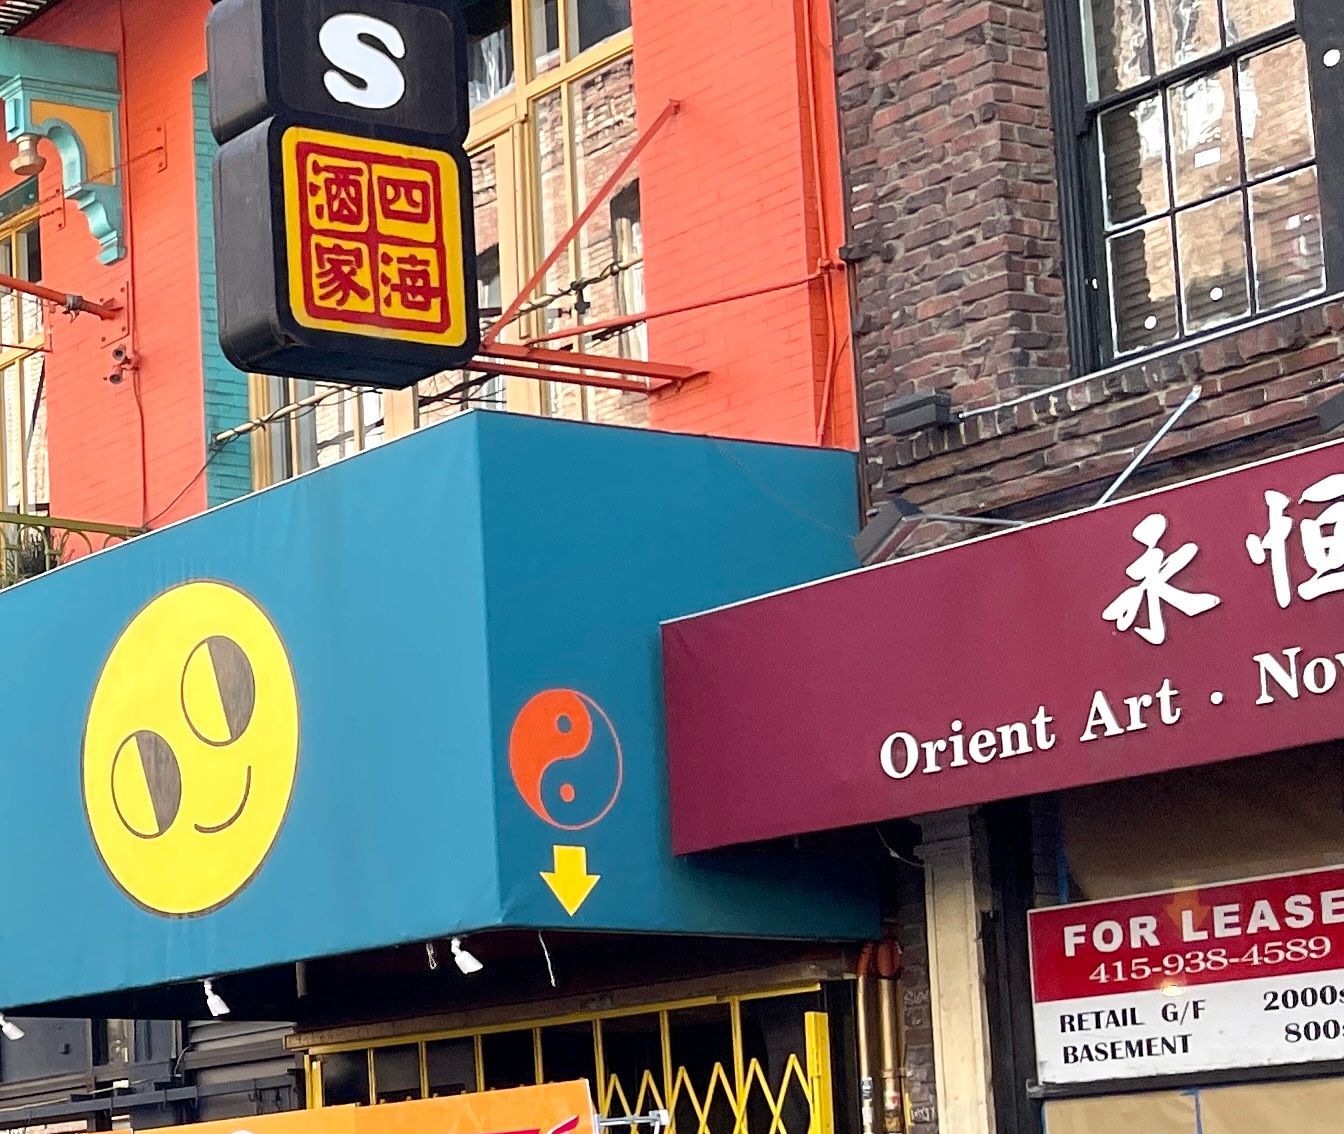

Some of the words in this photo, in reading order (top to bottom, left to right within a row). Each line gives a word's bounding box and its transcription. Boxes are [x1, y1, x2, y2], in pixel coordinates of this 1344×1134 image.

[318, 12, 407, 110] S
[880, 705, 1056, 780] Orient
[1080, 678, 1181, 742] Art
[1064, 916, 1161, 957] FOR
[1182, 889, 1344, 942] LEASE
[1089, 936, 1331, 984] 415-938-4589
[1060, 1007, 1145, 1033] RETAIL
[1162, 1000, 1207, 1025] G/F
[1063, 1034, 1193, 1065] BASEMENT
[1284, 1018, 1344, 1044] 800
